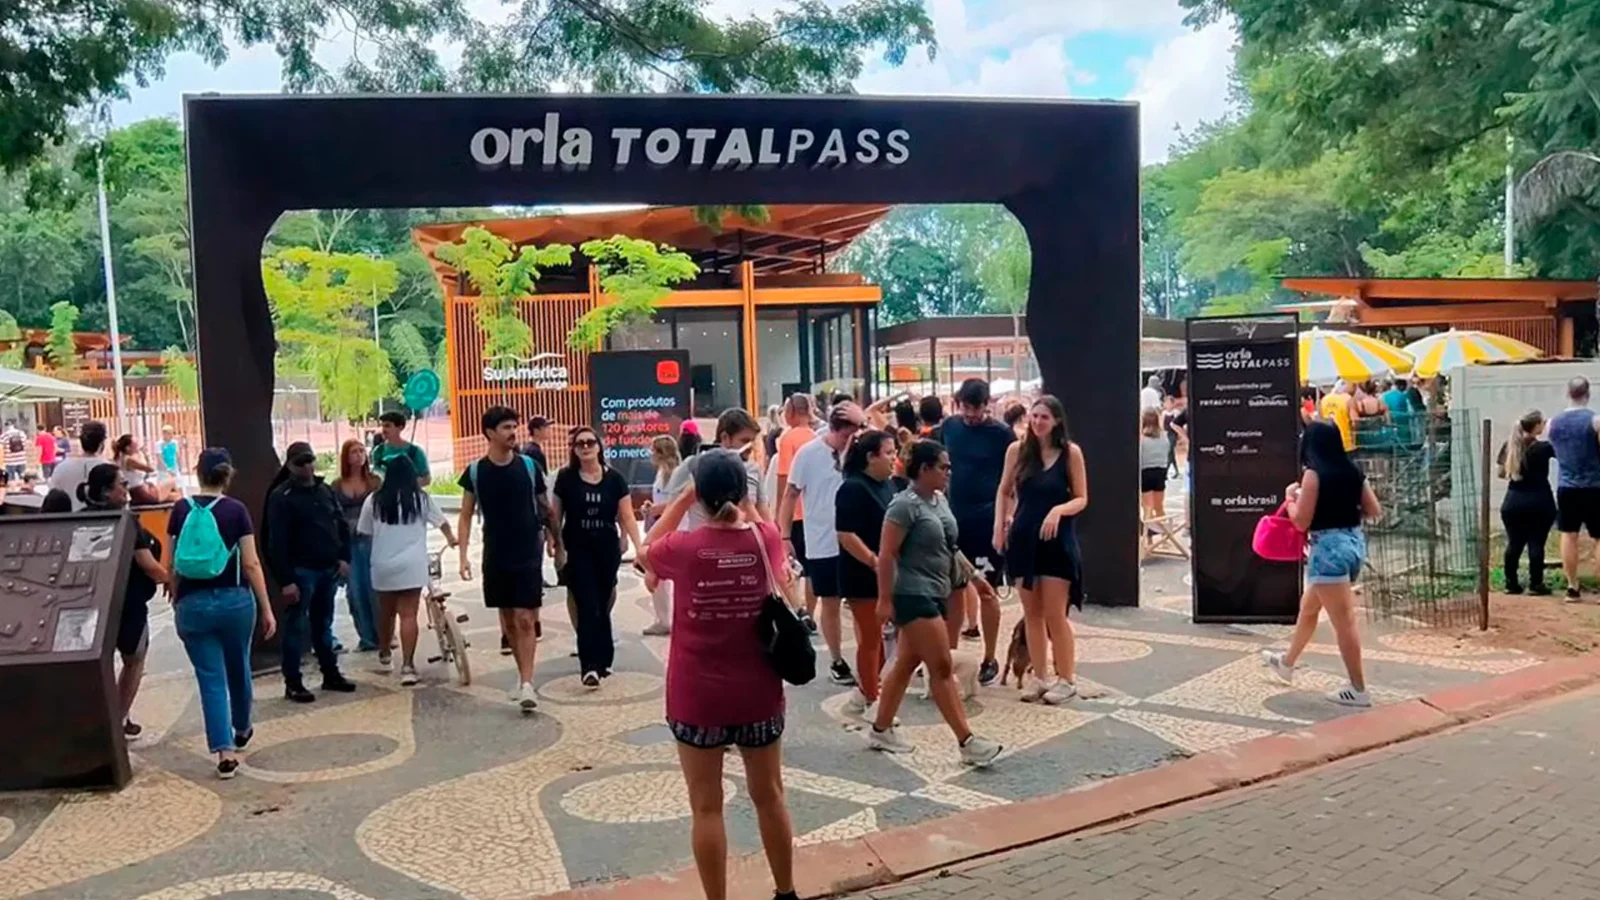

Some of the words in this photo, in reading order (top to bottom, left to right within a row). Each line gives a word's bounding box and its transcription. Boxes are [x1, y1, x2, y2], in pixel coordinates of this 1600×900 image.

[470, 112, 593, 165] orla
[610, 127, 911, 165] TOTALPASS
[1225, 348, 1252, 359] orla
[1225, 358, 1290, 368] TOTALPASS
[601, 397, 626, 408] Com
[627, 396, 676, 410] produtos
[601, 410, 616, 421] de
[603, 423, 621, 434] 120
[622, 422, 670, 435] gestores
[619, 435, 655, 445] fundo
[603, 447, 618, 459] do
[1224, 494, 1247, 506] orla
[1248, 494, 1277, 506] brasil
